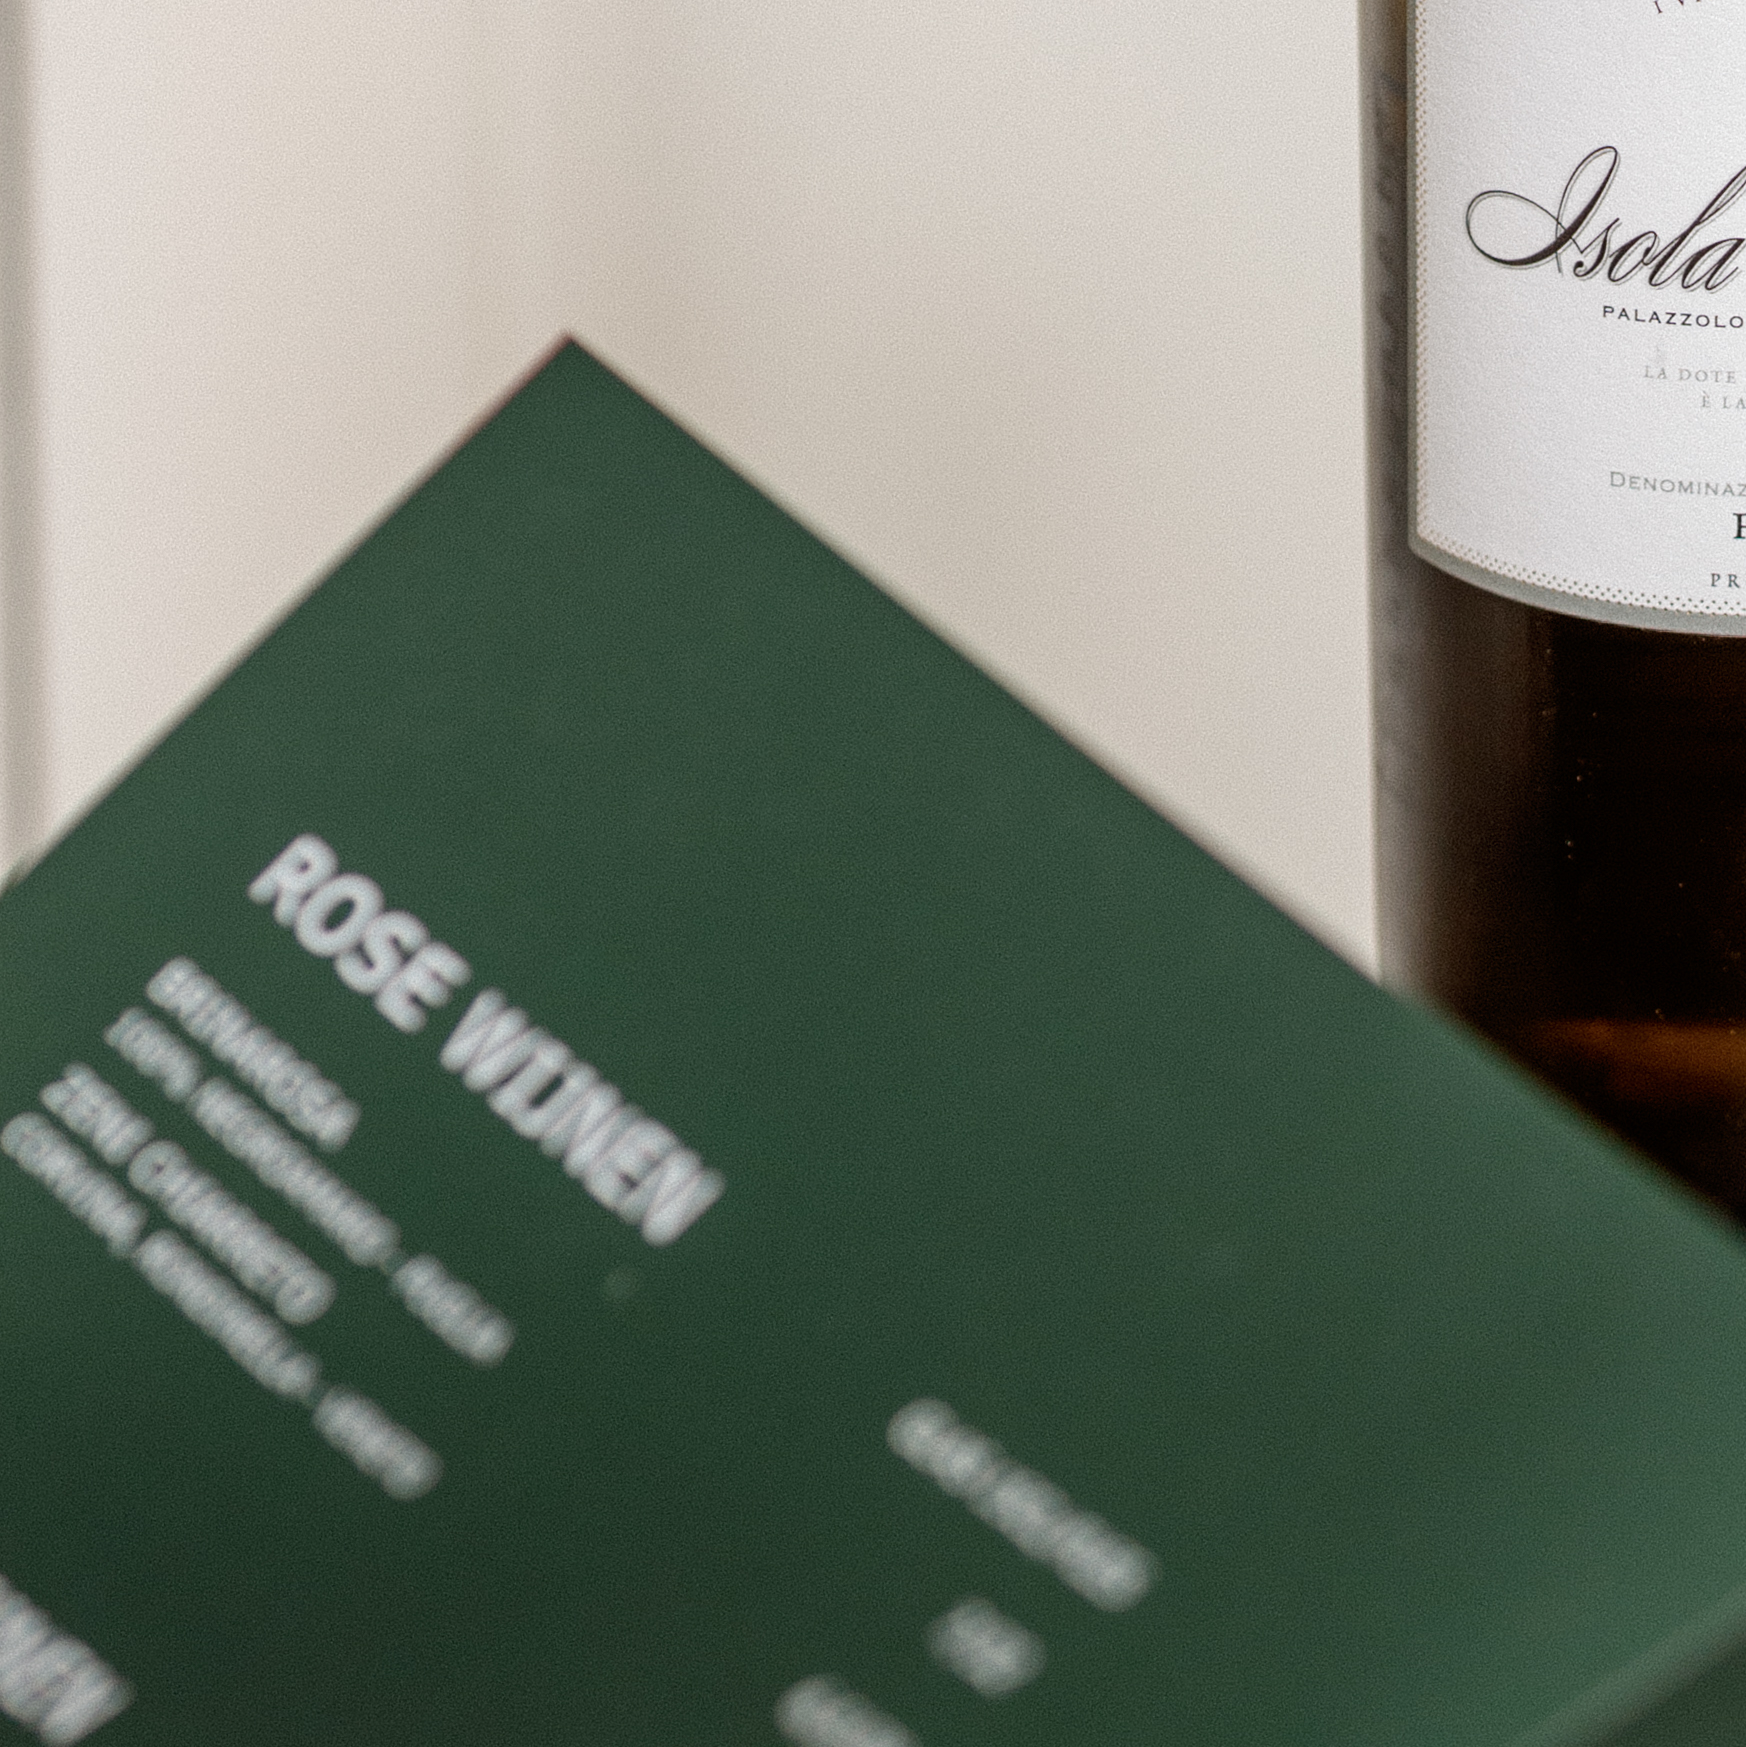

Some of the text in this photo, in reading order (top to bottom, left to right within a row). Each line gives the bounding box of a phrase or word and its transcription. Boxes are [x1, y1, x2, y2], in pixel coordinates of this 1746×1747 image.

[1602, 305, 1744, 329] PALAZZOLO
[1643, 365, 1668, 381] LA
[1678, 368, 1737, 384] DOTE
[1722, 396, 1746, 410] LA
[248, 834, 470, 1034] ROSE
